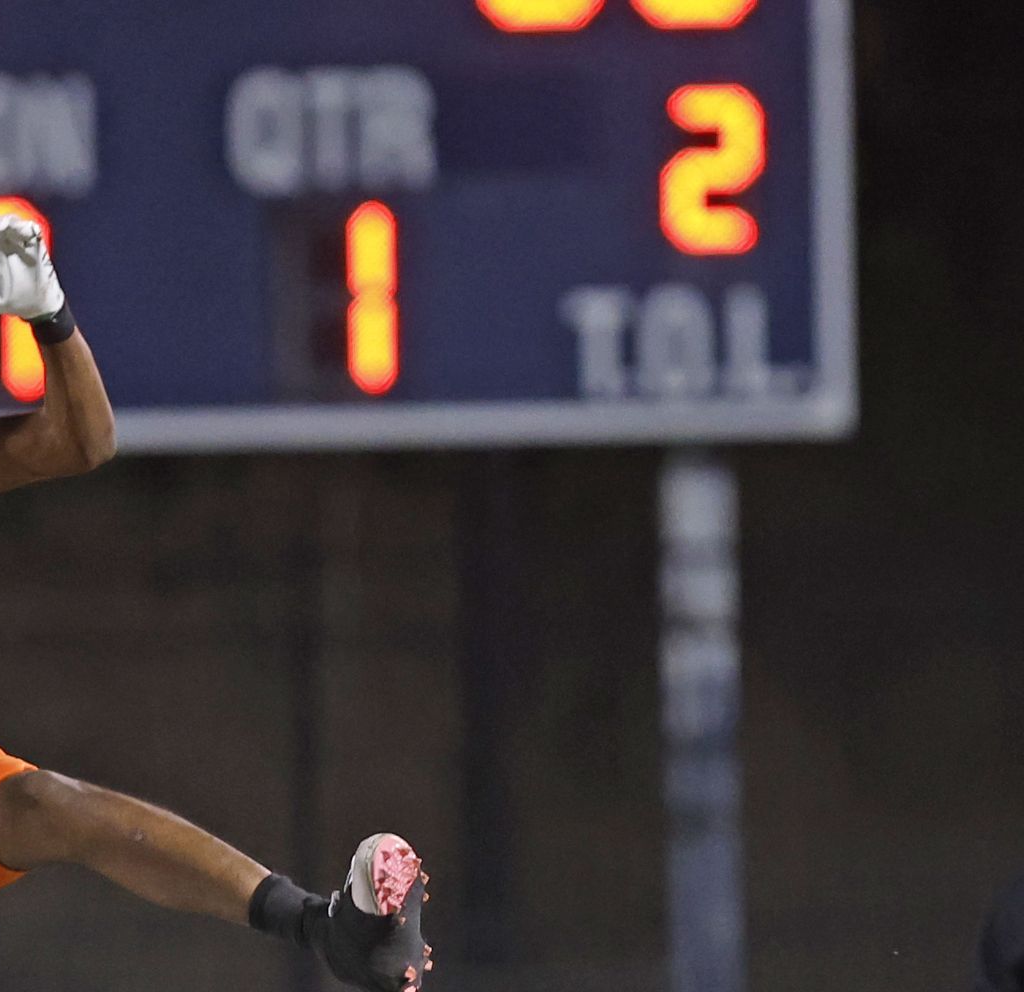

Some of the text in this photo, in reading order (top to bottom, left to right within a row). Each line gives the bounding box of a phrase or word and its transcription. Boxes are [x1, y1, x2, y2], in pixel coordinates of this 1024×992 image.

[226, 68, 434, 194] QTR
[659, 83, 766, 256] 2
[346, 200, 399, 395] 1
